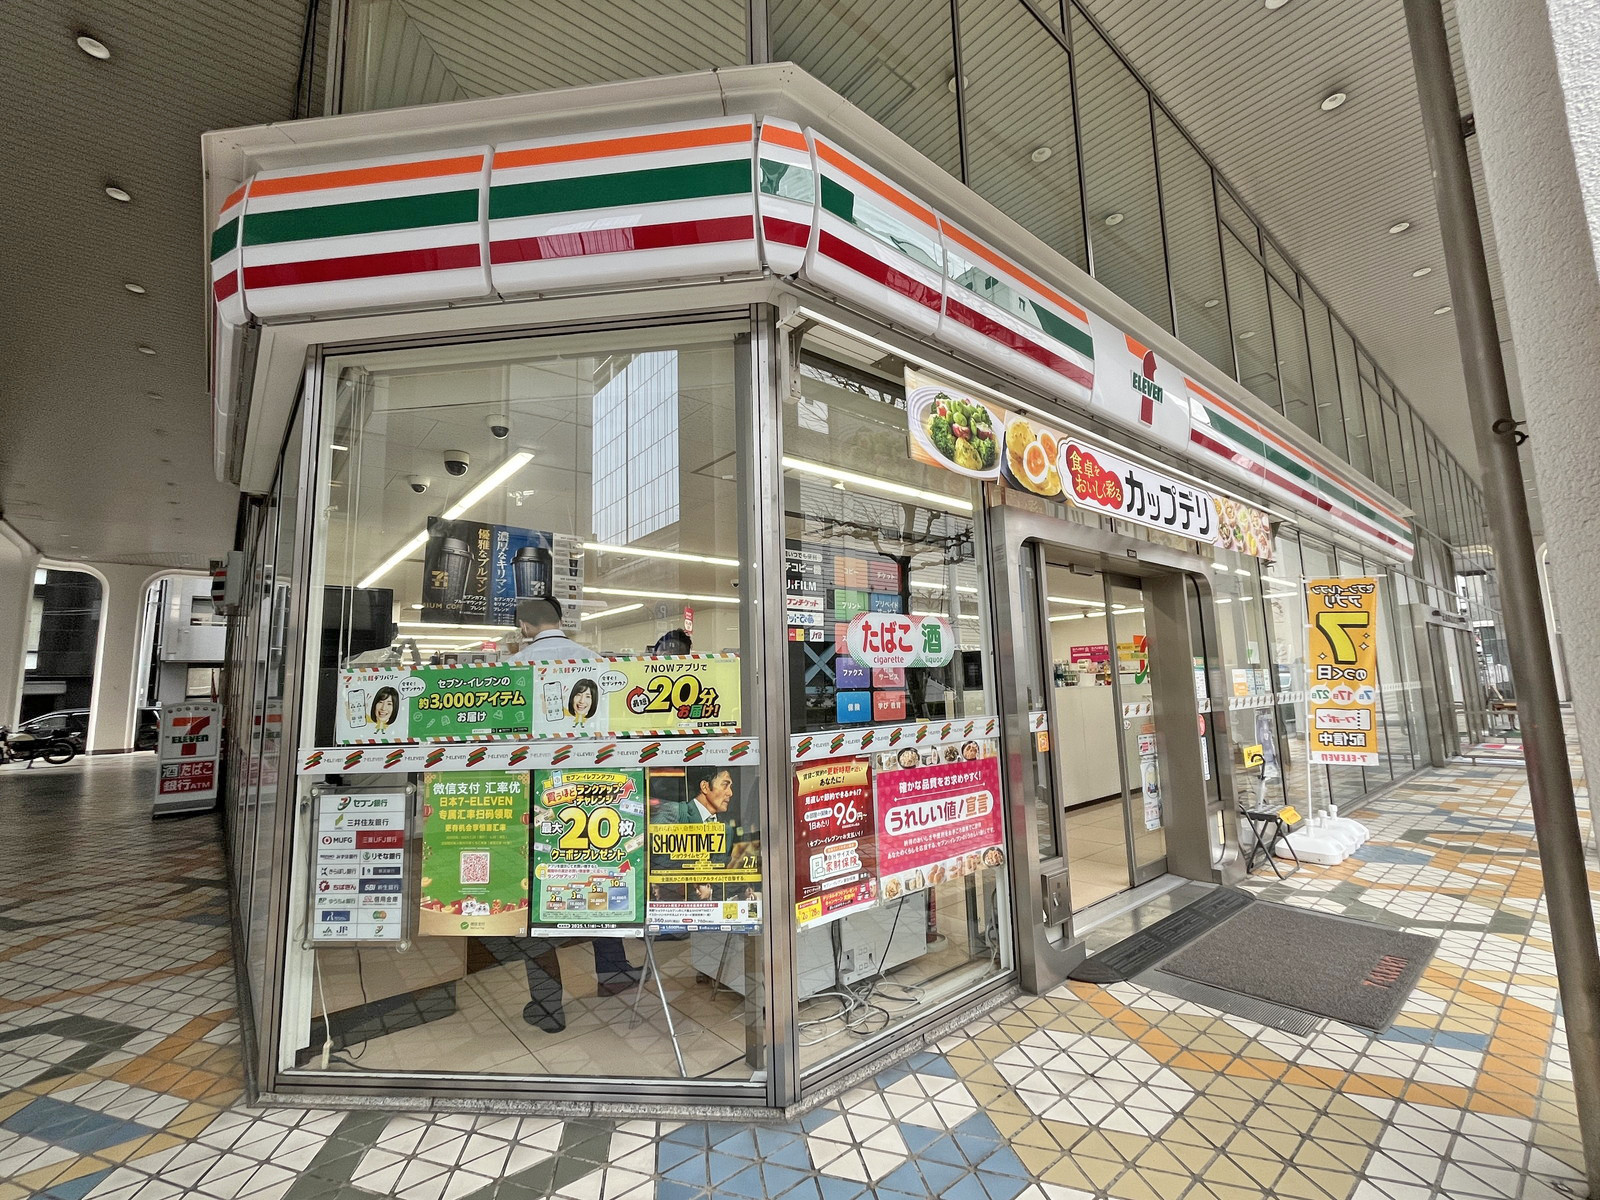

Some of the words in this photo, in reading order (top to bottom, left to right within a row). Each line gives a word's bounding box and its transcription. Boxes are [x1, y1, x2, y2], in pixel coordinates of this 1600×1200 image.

[1069, 450, 1100, 479] 食卓を
[1075, 475, 1123, 502] おいしく彩る
[1125, 470, 1212, 535] カップデリ
[496, 531, 510, 594] 濃厚なキリマン
[877, 572, 897, 580] チケット
[875, 600, 899, 609] プリペイド
[861, 620, 914, 654] たばこ
[921, 623, 942, 654] 酒
[873, 655, 905, 665] cigarette
[925, 655, 943, 664] liquor
[843, 669, 864, 677] ファクス
[418, 691, 526, 710] 約3,000アイテム
[632, 698, 648, 709] 最短
[457, 711, 487, 723] お届け
[677, 703, 722, 720] お届け!
[162, 764, 179, 778] 酒
[180, 762, 213, 777] たばこ
[820, 776, 845, 786] あなたに!
[898, 771, 982, 794] 確かな品質をお求めやすく!
[433, 782, 481, 795] 微信支付
[485, 781, 521, 794] 汇率优
[576, 783, 623, 795] ランクアップ
[546, 786, 576, 804] 買うほど
[576, 795, 614, 806] チャレンジ
[354, 799, 388, 808] セブン銀行
[439, 809, 513, 820] 专属汇率扫码领取
[347, 818, 389, 827] 三井住友銀行
[808, 820, 830, 830] 1日あたり
[653, 833, 715, 853] SHOWTIME
[551, 849, 626, 861] クーポンプレゼント
